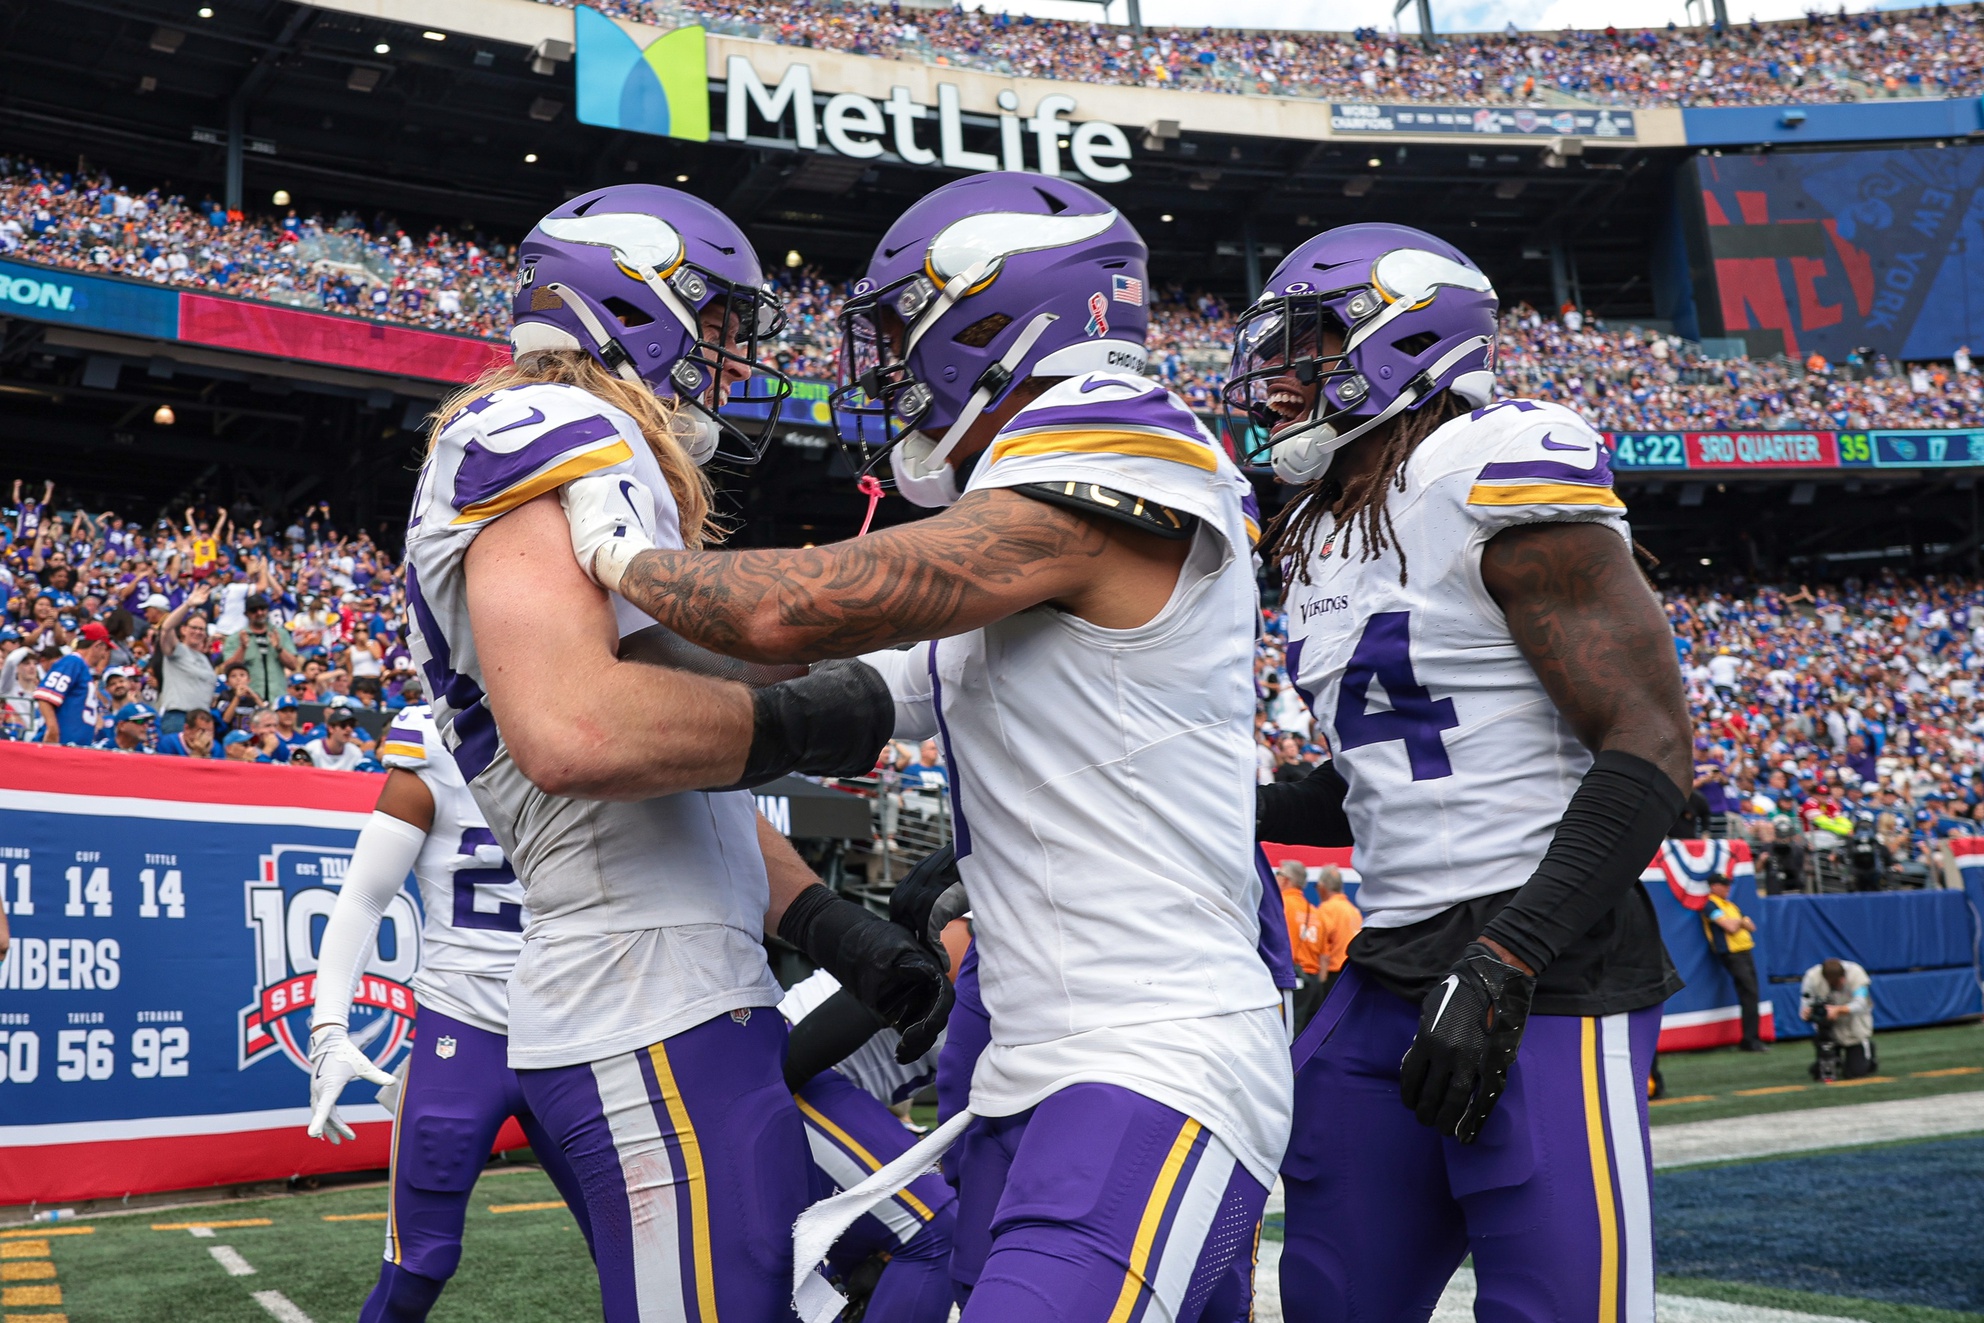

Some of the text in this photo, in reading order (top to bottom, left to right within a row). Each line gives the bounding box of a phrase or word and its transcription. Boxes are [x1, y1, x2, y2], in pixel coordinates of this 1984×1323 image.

[726, 54, 1133, 184] MetLife
[1618, 435, 1683, 464] 4:22
[1698, 435, 1735, 462] 3RD
[1738, 435, 1822, 462] QUARTER
[1841, 435, 1869, 461] 35
[1300, 594, 1348, 624] VIKINGS
[44, 671, 72, 693] 56
[75, 851, 101, 863] CUFF
[144, 853, 178, 866] TITTLE
[296, 863, 319, 876] EST.
[64, 866, 113, 918] 14
[138, 868, 186, 919] 14
[67, 1012, 105, 1025] TAYLOR
[136, 1010, 184, 1023] STRAHAN
[57, 1028, 115, 1082] 56
[131, 1026, 190, 1079] 92
